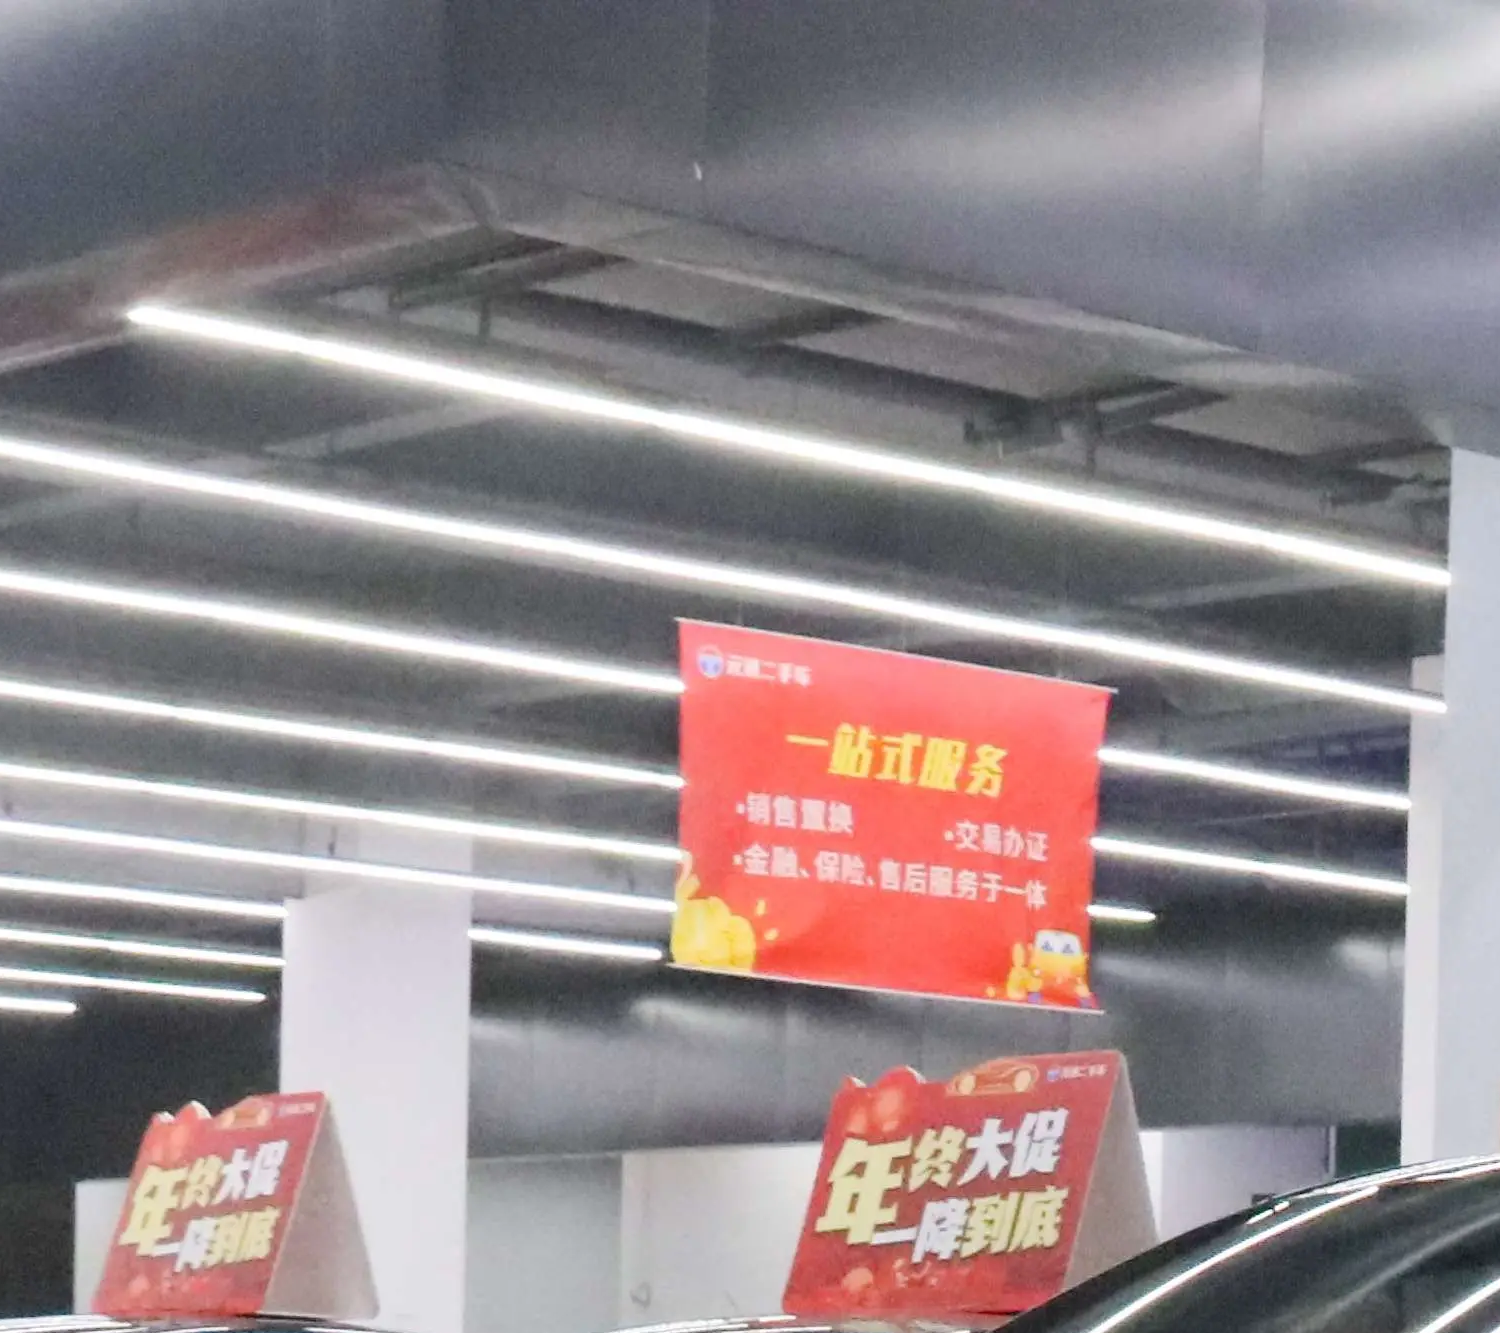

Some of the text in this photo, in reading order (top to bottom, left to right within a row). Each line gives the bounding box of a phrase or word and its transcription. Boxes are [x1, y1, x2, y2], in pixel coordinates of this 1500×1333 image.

[785, 722, 1008, 798] 一站式服务
[816, 1108, 1070, 1246] 年终大促
[870, 1187, 1069, 1264] 一降到底
